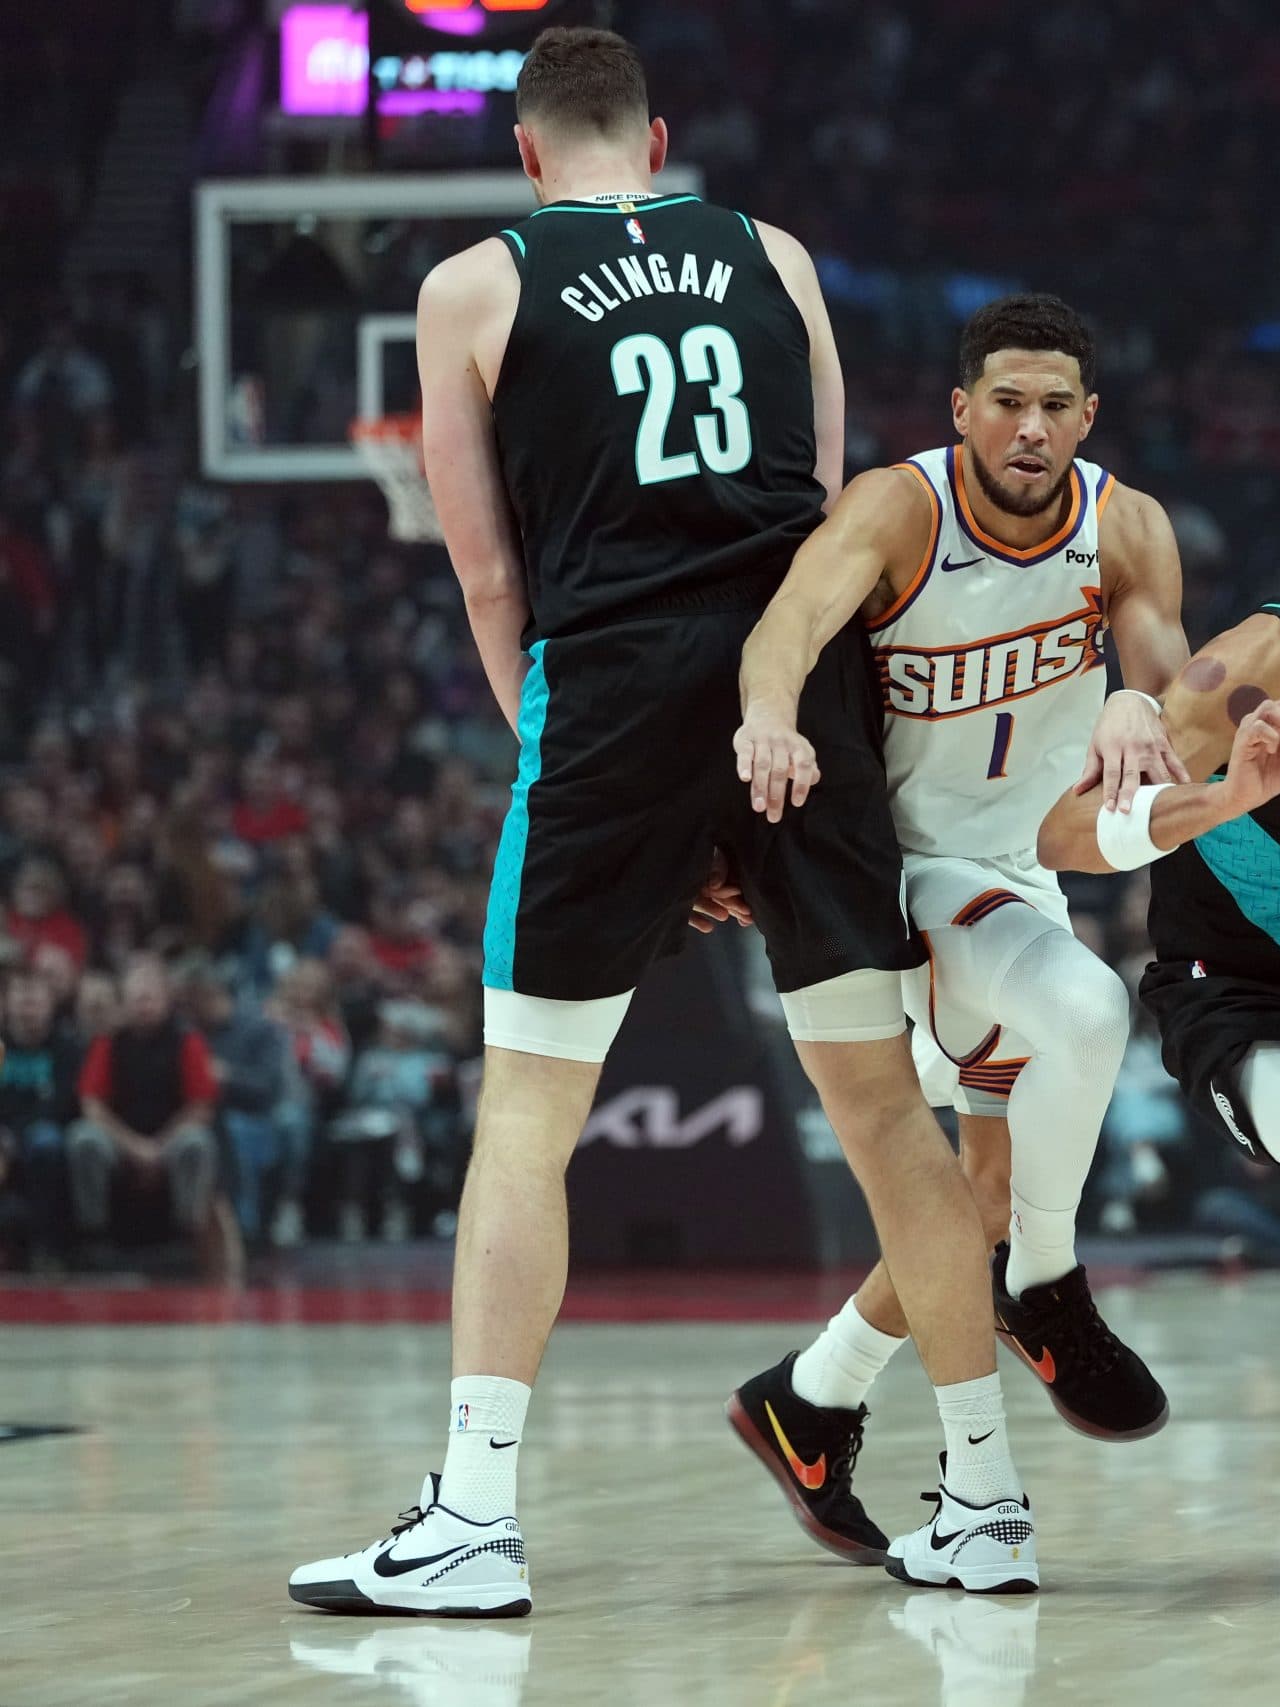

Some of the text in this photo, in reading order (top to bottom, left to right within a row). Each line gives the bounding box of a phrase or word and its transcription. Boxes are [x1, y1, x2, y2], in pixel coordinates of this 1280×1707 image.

[595, 194, 624, 202] NIKE
[560, 253, 734, 322] CLINGAN
[610, 324, 752, 485] 23
[887, 618, 1089, 715] SUNS
[986, 712, 1015, 780] 1
[997, 1505, 1020, 1514] GIGI
